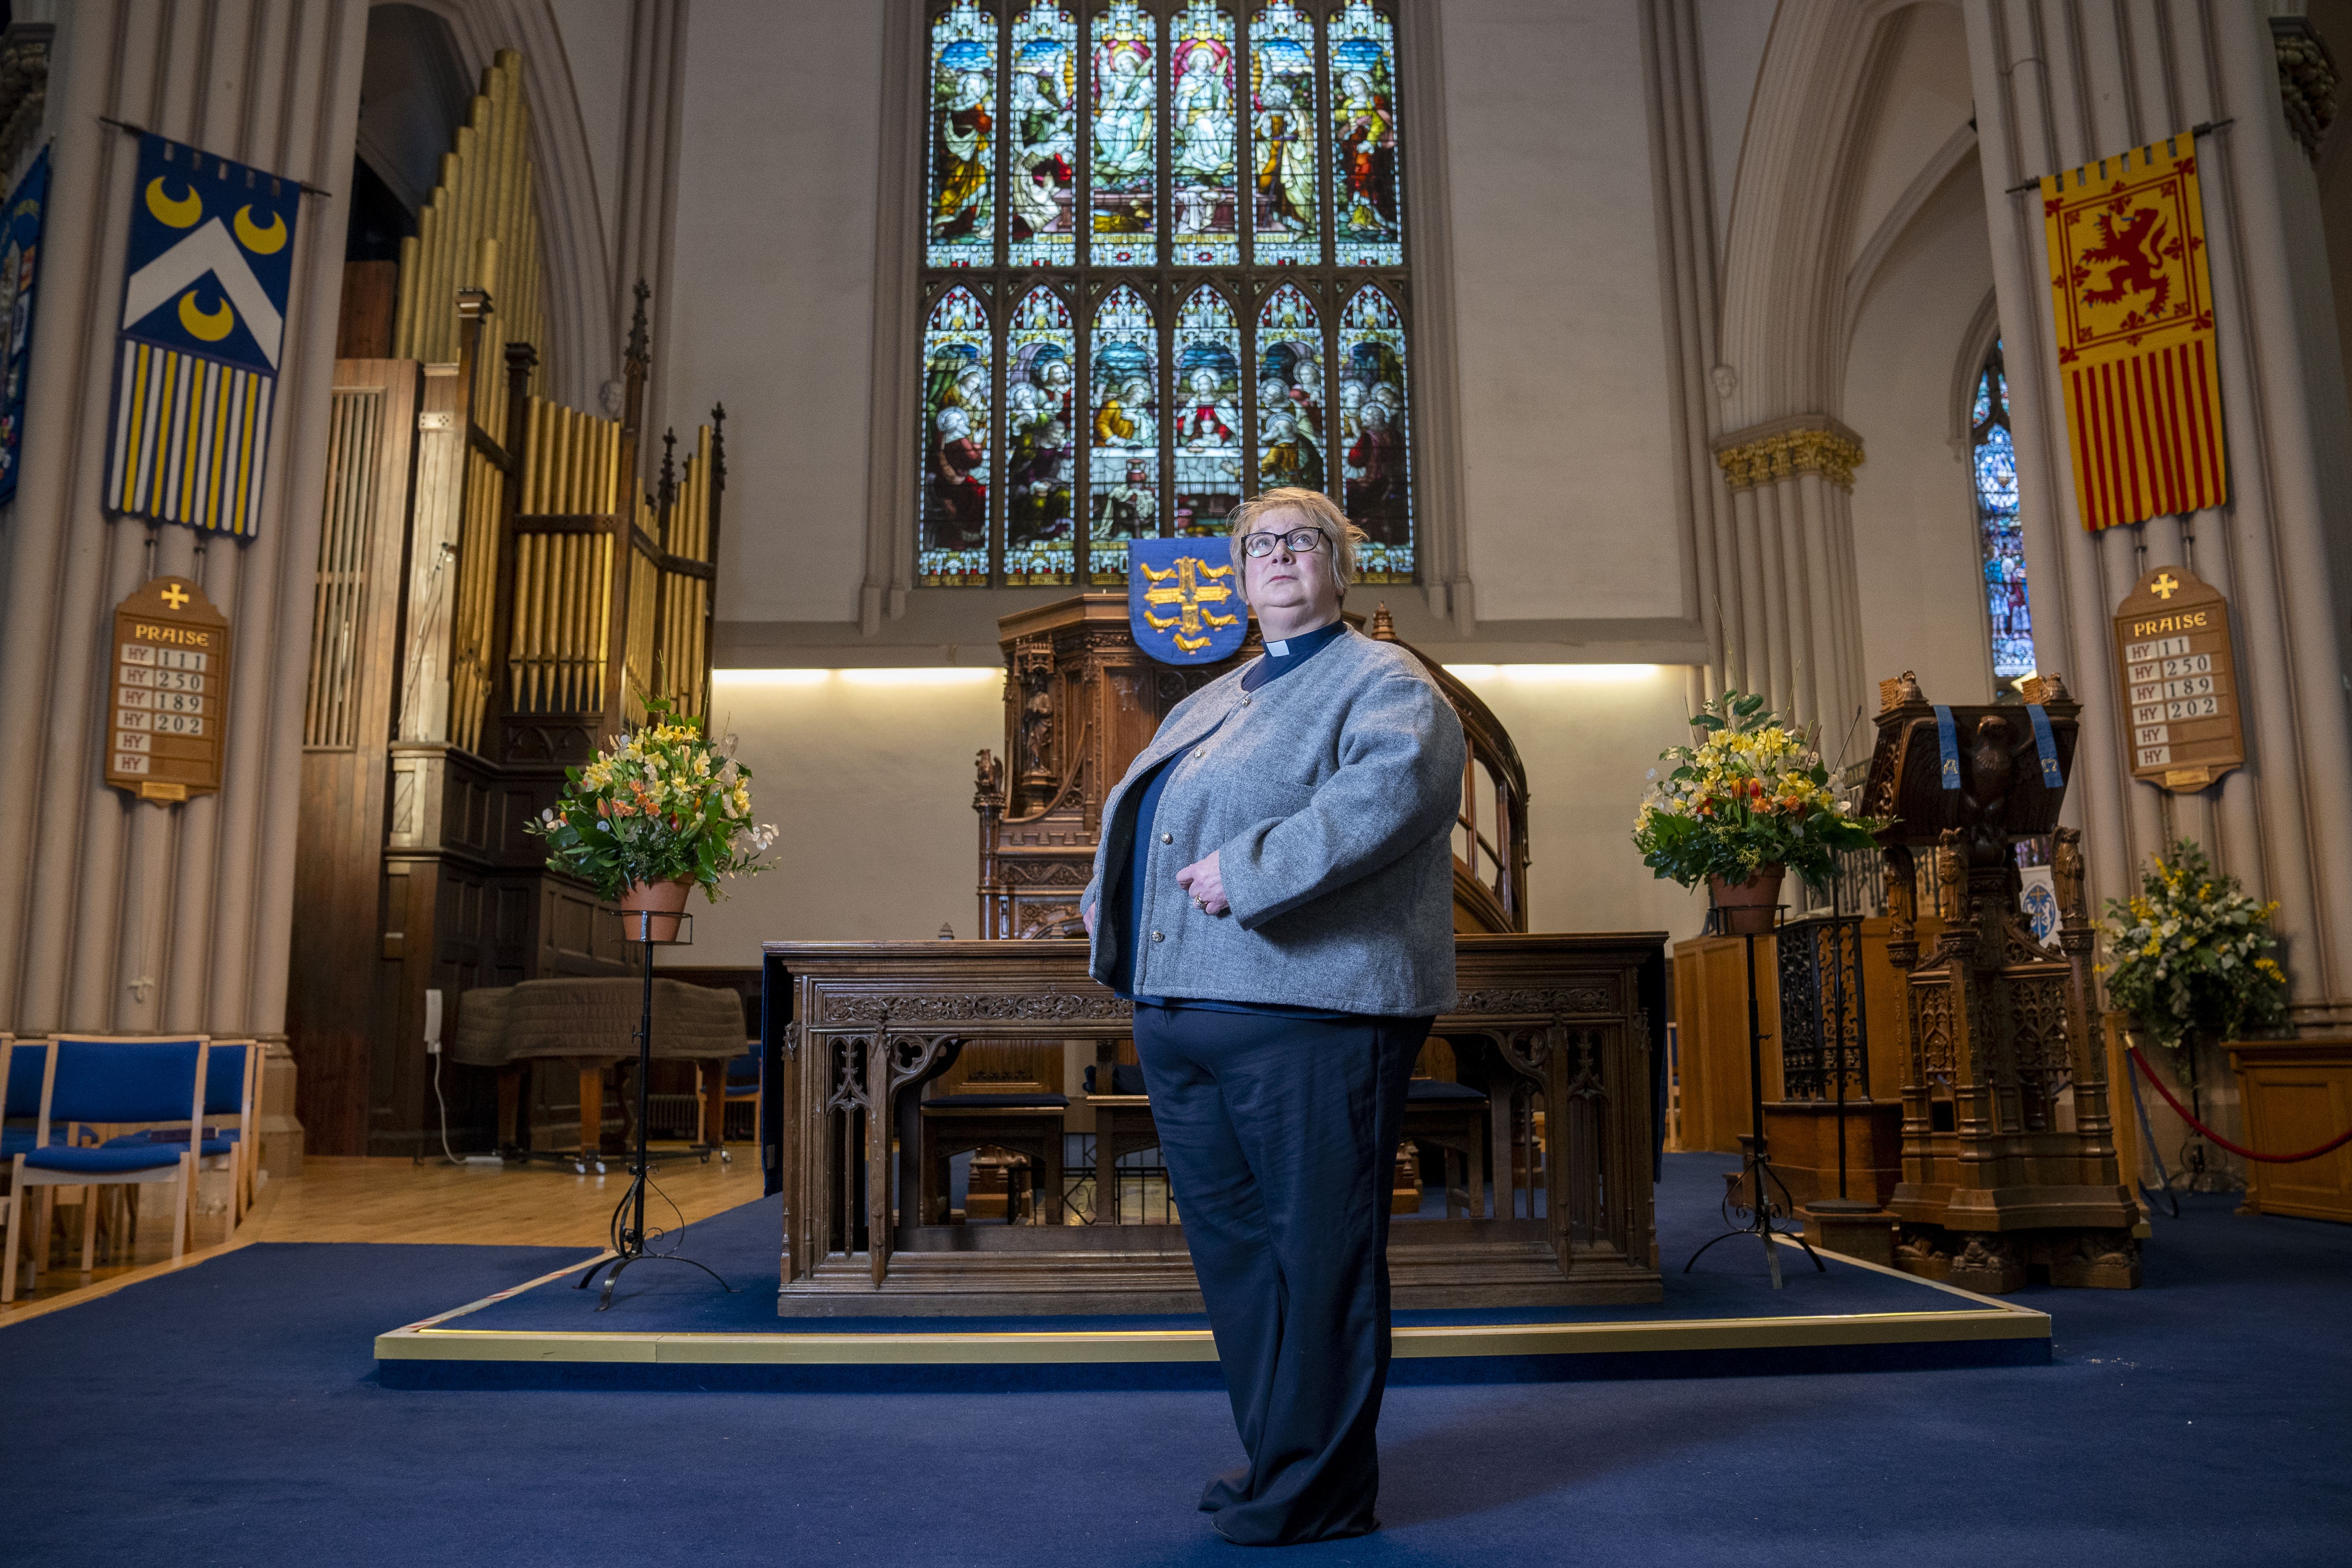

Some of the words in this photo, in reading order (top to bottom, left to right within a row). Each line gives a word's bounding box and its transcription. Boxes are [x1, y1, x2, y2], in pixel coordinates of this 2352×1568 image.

[2134, 612, 2207, 637] PRAISE
[135, 624, 209, 646] PRAISE
[128, 647, 147, 661] HY
[2132, 644, 2150, 659] HY
[2135, 665, 2153, 680] HY
[2167, 655, 2207, 676] 250
[127, 668, 146, 682] HY
[159, 671, 201, 690] 250
[2137, 686, 2155, 700] HY
[2170, 677, 2209, 698] 189
[125, 691, 145, 705] HY
[160, 693, 199, 712] 189
[2139, 707, 2157, 721] HY
[2171, 697, 2214, 719] 202
[124, 713, 143, 726] HY
[158, 714, 199, 733] 202
[124, 734, 143, 748] HY
[2142, 728, 2160, 743] HY
[122, 756, 142, 771] HY
[2144, 749, 2162, 763] HY
